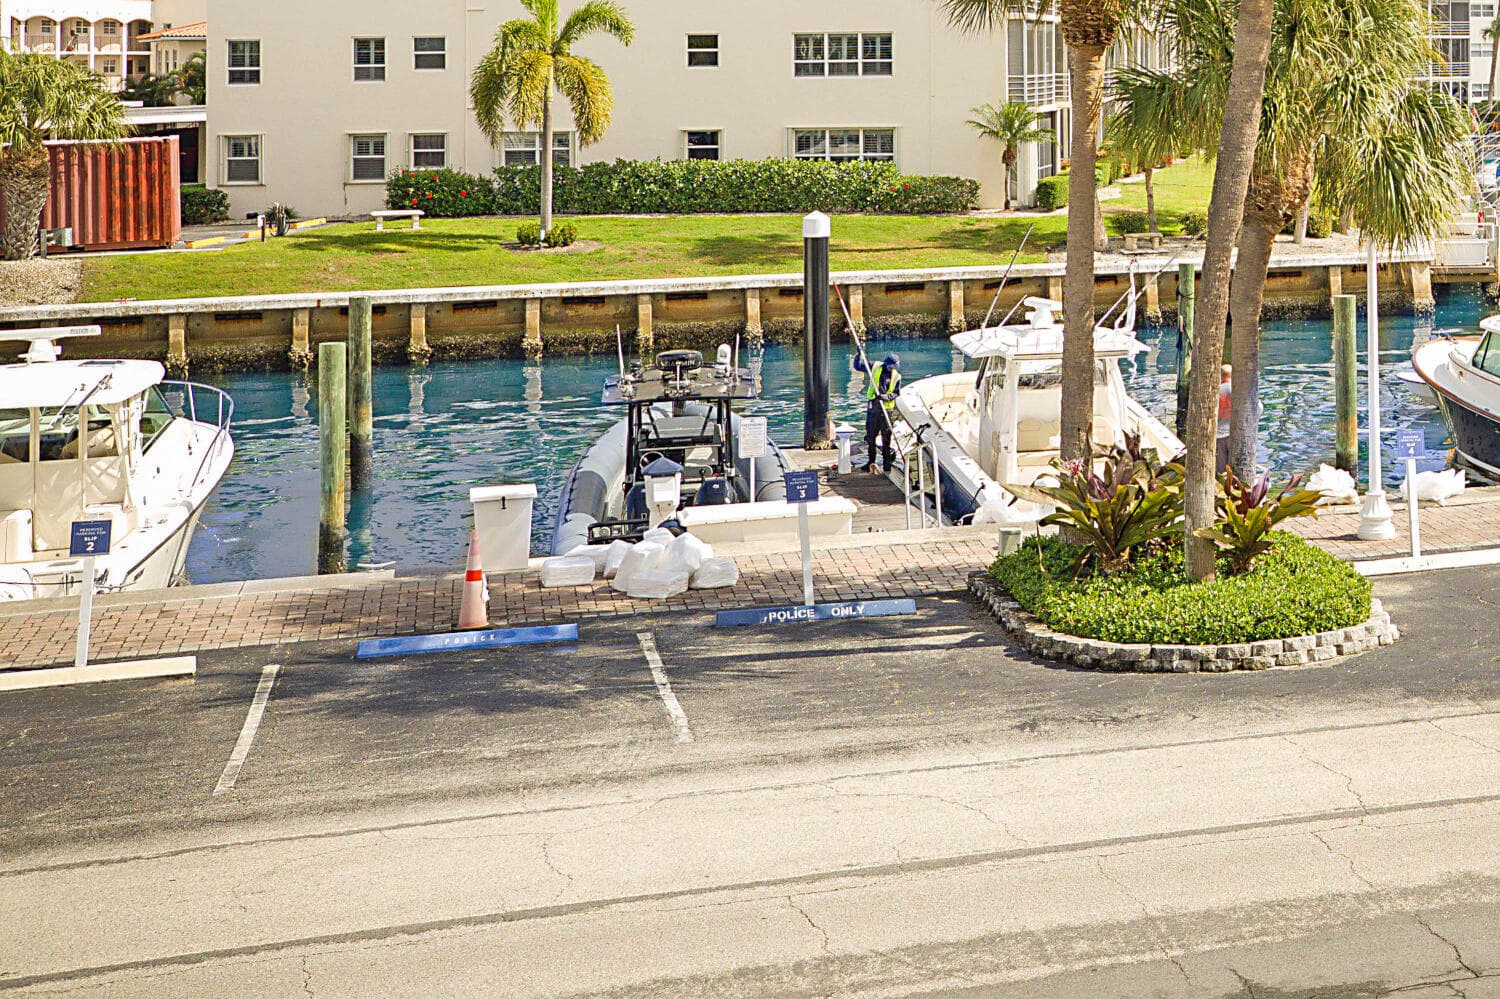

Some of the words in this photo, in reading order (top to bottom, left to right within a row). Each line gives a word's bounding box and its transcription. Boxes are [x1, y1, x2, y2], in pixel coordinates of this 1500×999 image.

[1408, 446, 1415, 456] 4
[799, 489, 806, 499] 3
[85, 541, 95, 551] 2
[768, 606, 815, 621] POLICE
[831, 605, 865, 617] ONLY
[444, 633, 495, 645] POLICE
